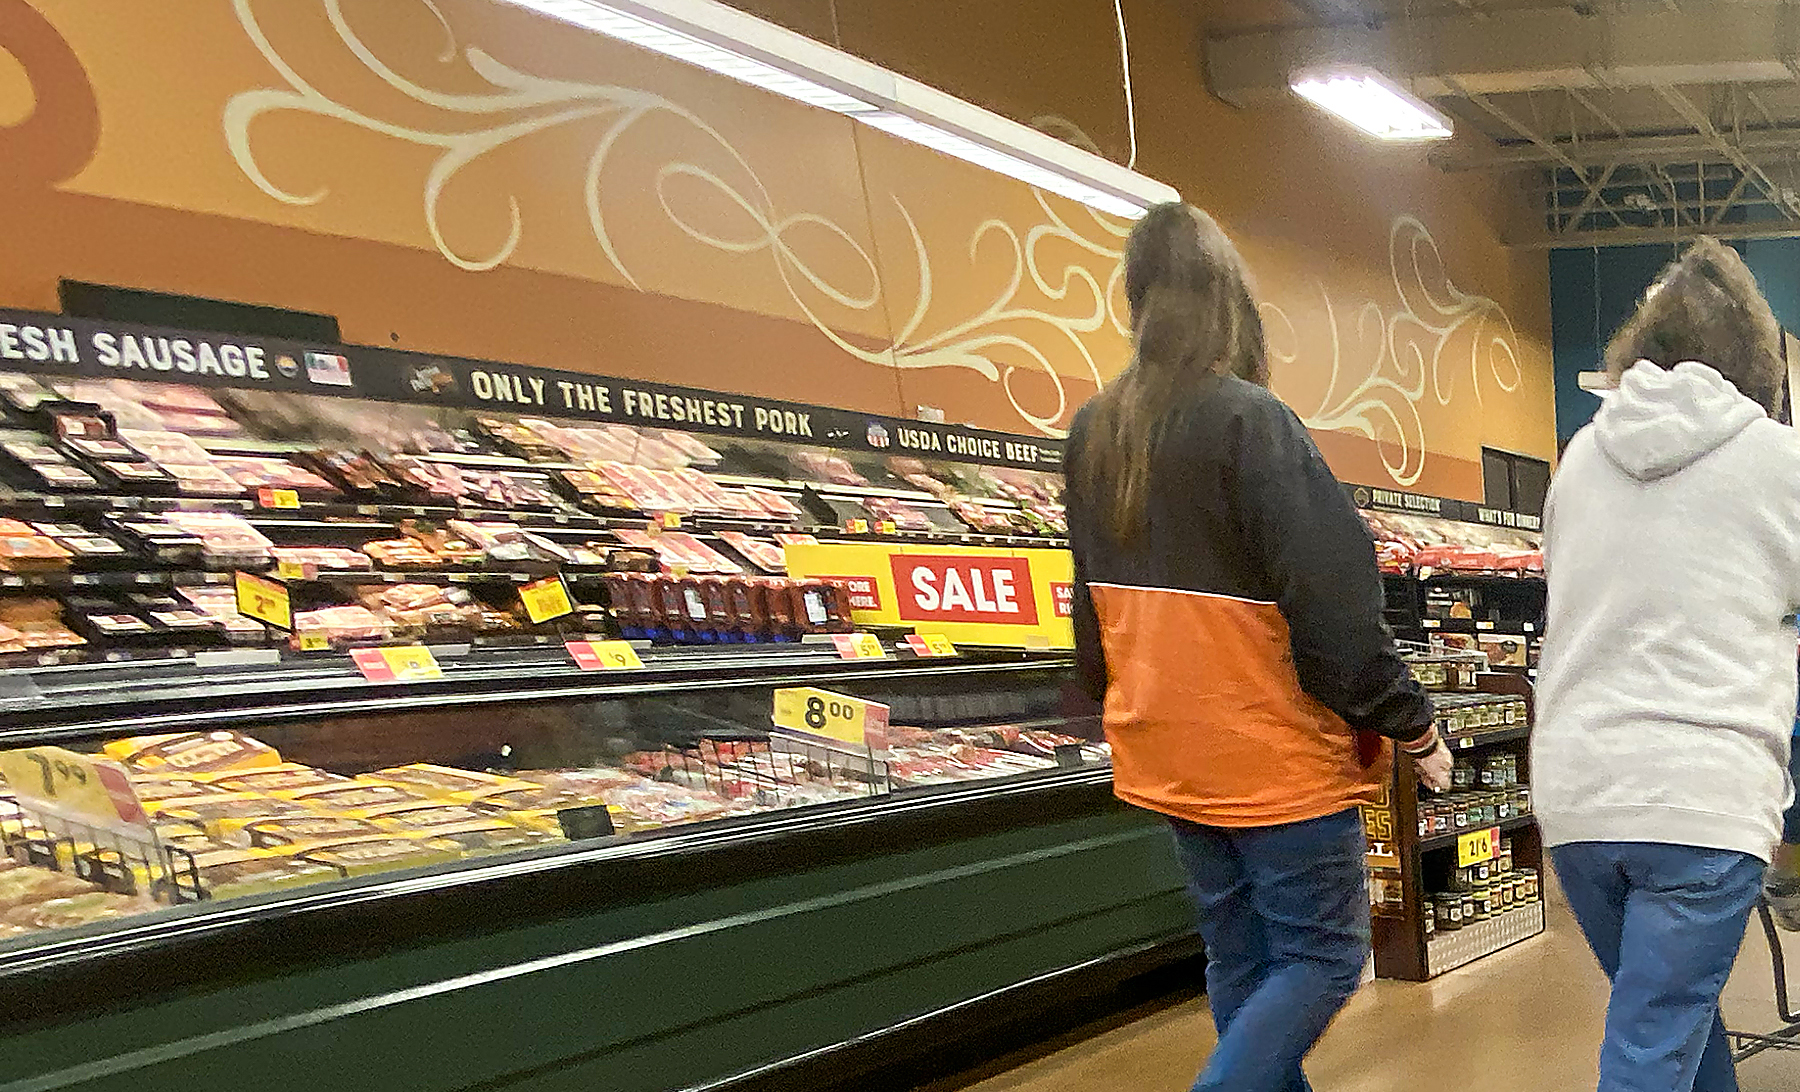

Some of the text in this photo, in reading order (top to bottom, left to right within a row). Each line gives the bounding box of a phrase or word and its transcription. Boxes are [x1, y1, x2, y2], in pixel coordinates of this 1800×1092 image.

[93, 331, 270, 379] SAUSAGE
[470, 370, 813, 438] ONLY THE FRESHEST PORK
[898, 427, 941, 451] USDA
[946, 434, 1001, 459] CHOICE
[1006, 441, 1038, 463] BEEF
[1372, 489, 1440, 511] PRIVATE SELECTION
[910, 566, 1019, 613] SALE
